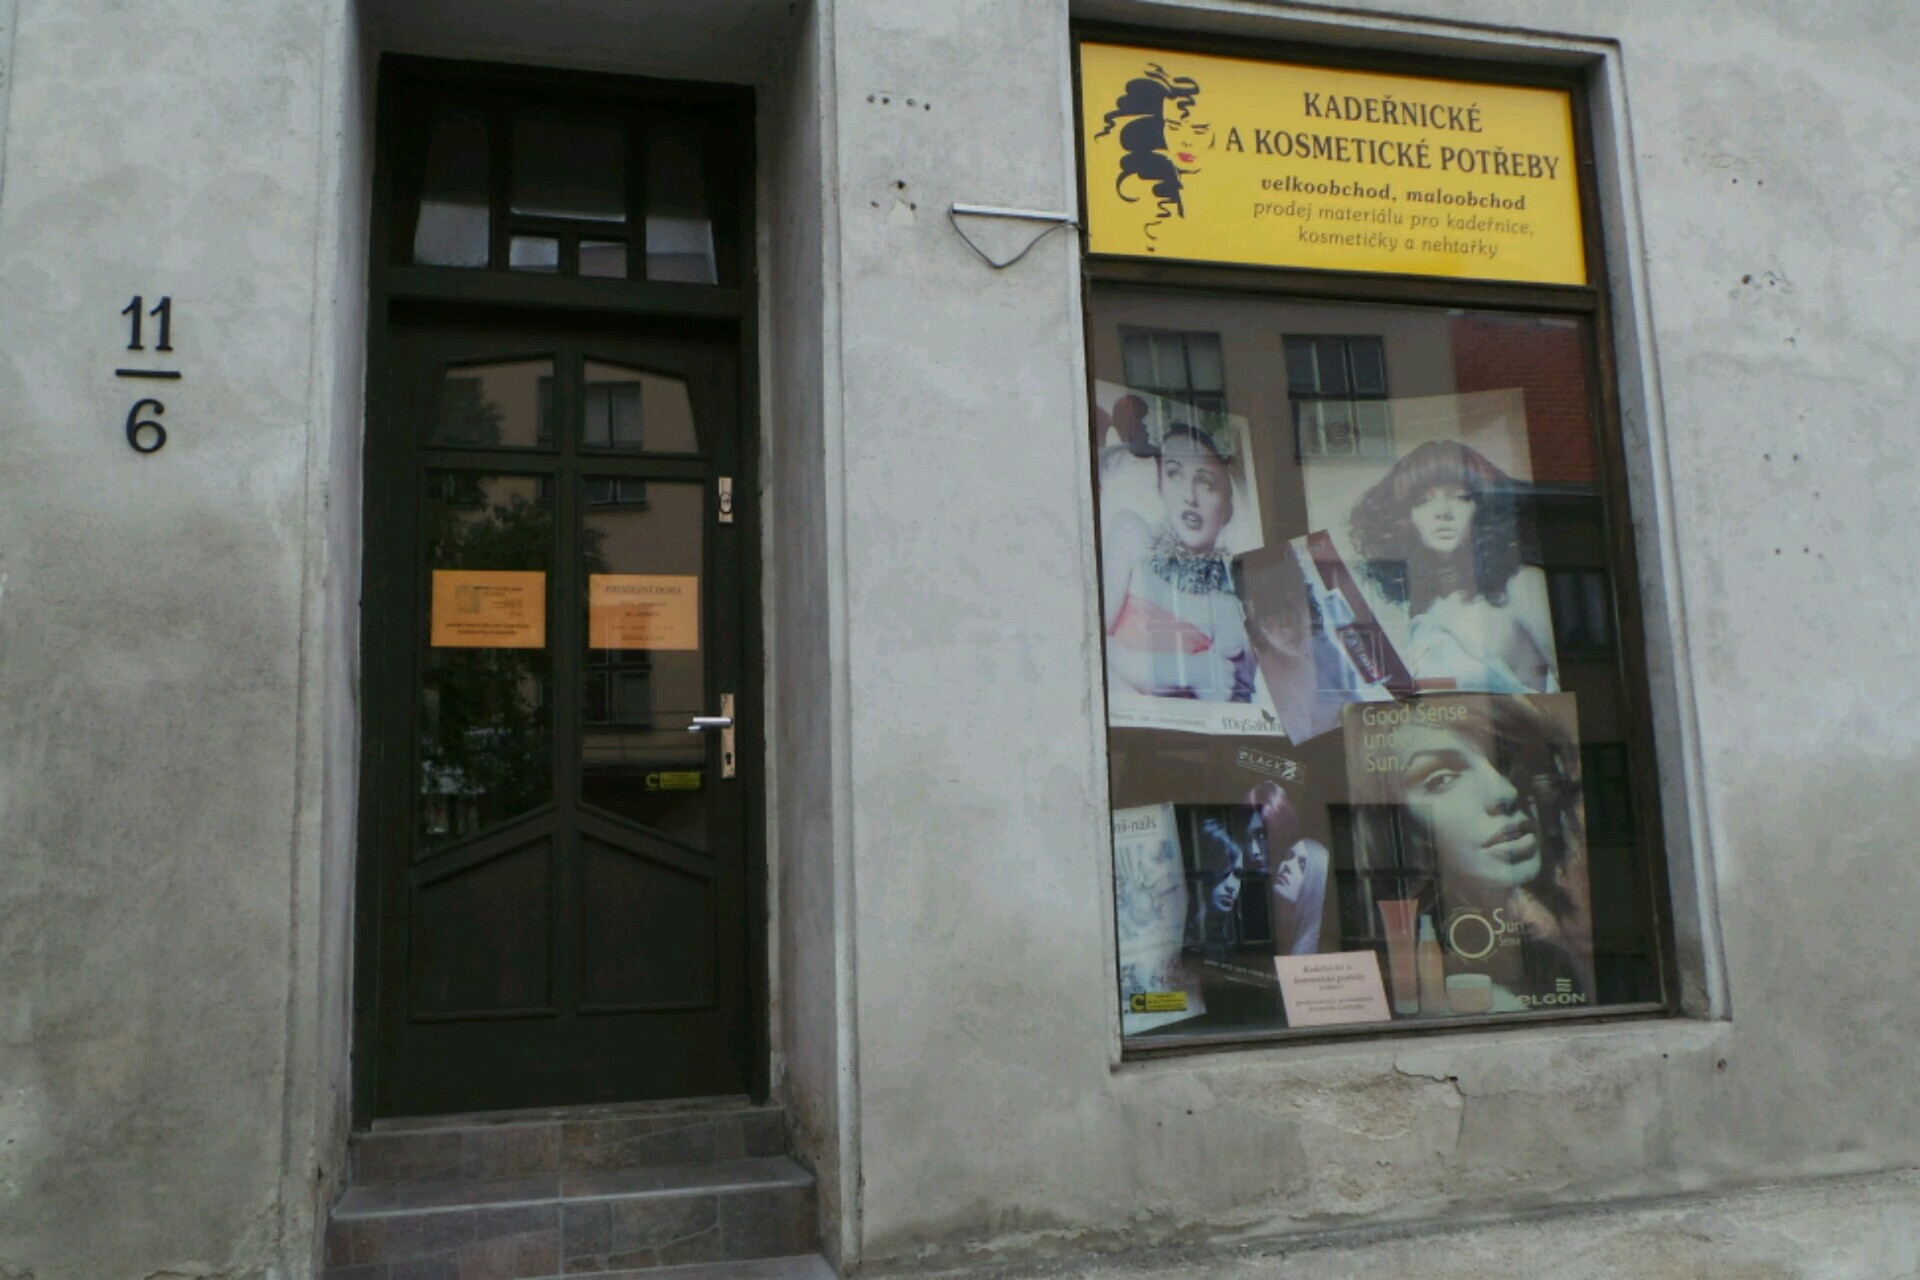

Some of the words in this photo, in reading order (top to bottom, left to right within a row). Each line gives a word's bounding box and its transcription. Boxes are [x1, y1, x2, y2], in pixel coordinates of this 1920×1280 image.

[1303, 92, 1483, 133] KADEŘNICKÉ
[1225, 126, 1245, 152] A
[1254, 128, 1431, 169] KOSMETICKÉ
[1440, 145, 1559, 180] POTŘEBY
[1261, 175, 1397, 203] velkoobchod,
[1406, 187, 1526, 210] maloobchod
[1253, 199, 1312, 222] prodej
[1319, 206, 1403, 225] materiálu
[1410, 214, 1439, 230] pro
[1447, 212, 1534, 238] kadeřnice,
[1298, 225, 1399, 252] kosmetičky
[1404, 238, 1415, 250] a
[1422, 236, 1499, 260] nehtařky
[120, 295, 174, 353] 11
[126, 398, 167, 454] 6
[1362, 703, 1409, 726] Good
[1416, 703, 1468, 722] Sense
